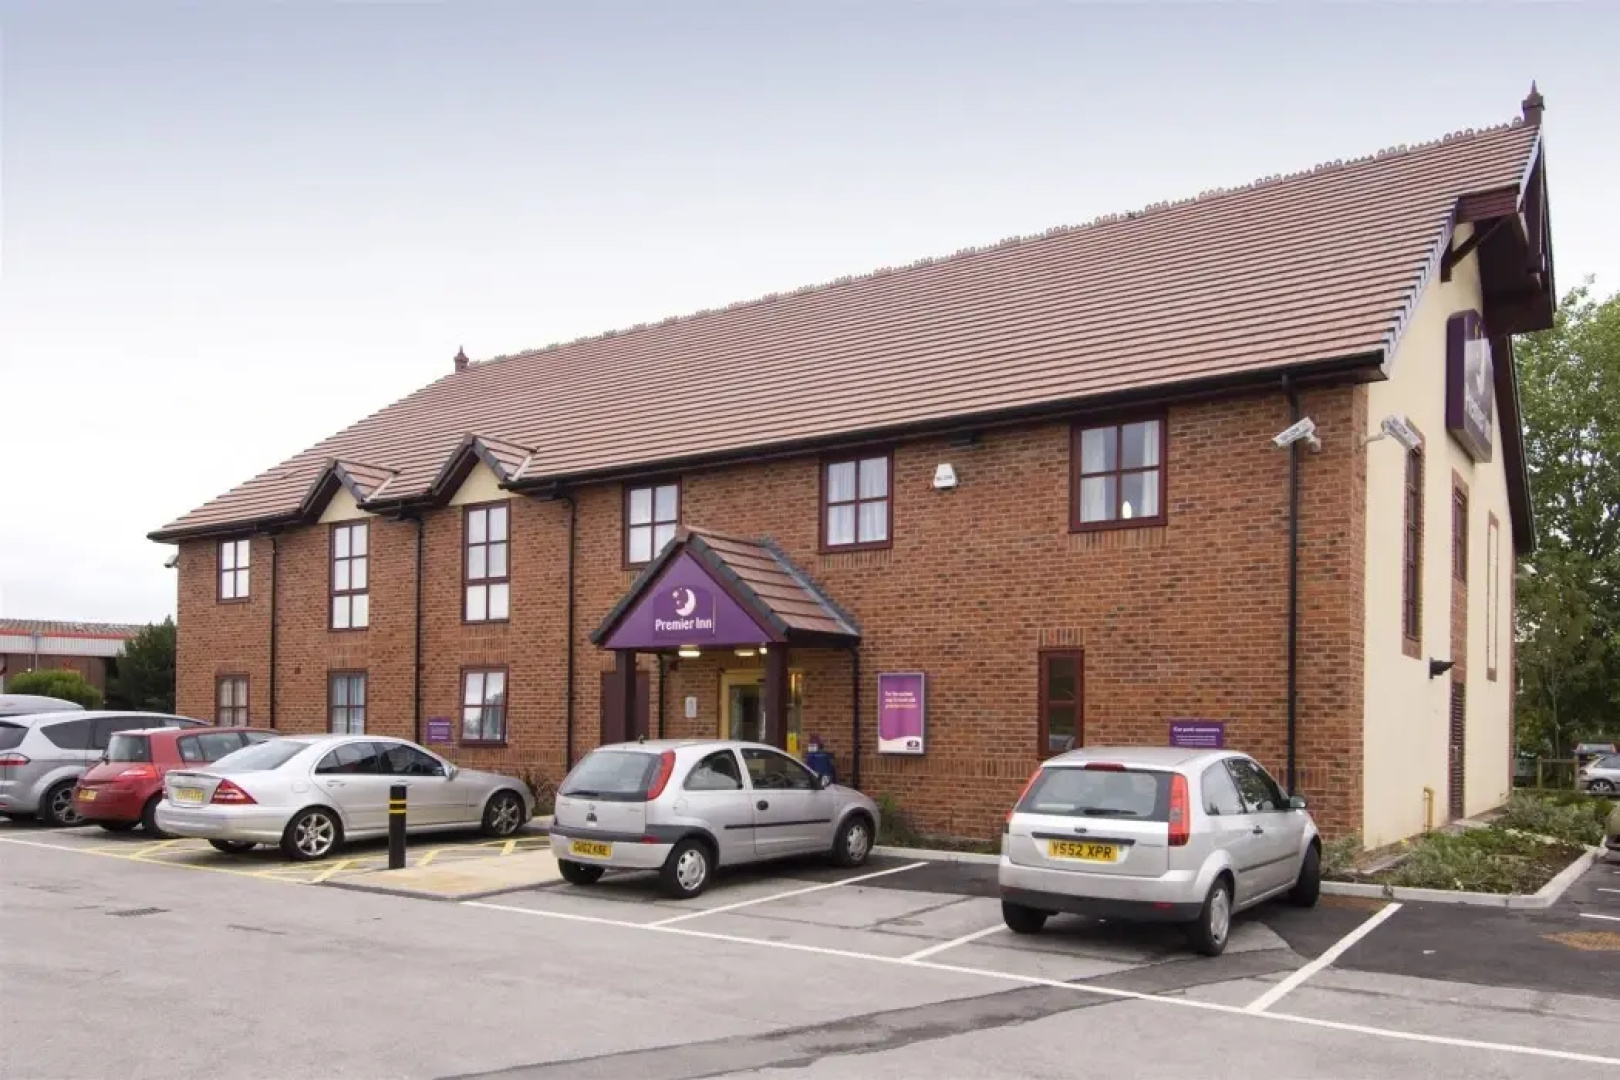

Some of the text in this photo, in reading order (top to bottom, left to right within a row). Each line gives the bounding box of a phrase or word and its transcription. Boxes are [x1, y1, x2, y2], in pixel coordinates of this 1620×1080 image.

[655, 617, 712, 631] Premier Inn
[1087, 845, 1112, 859] XPR
